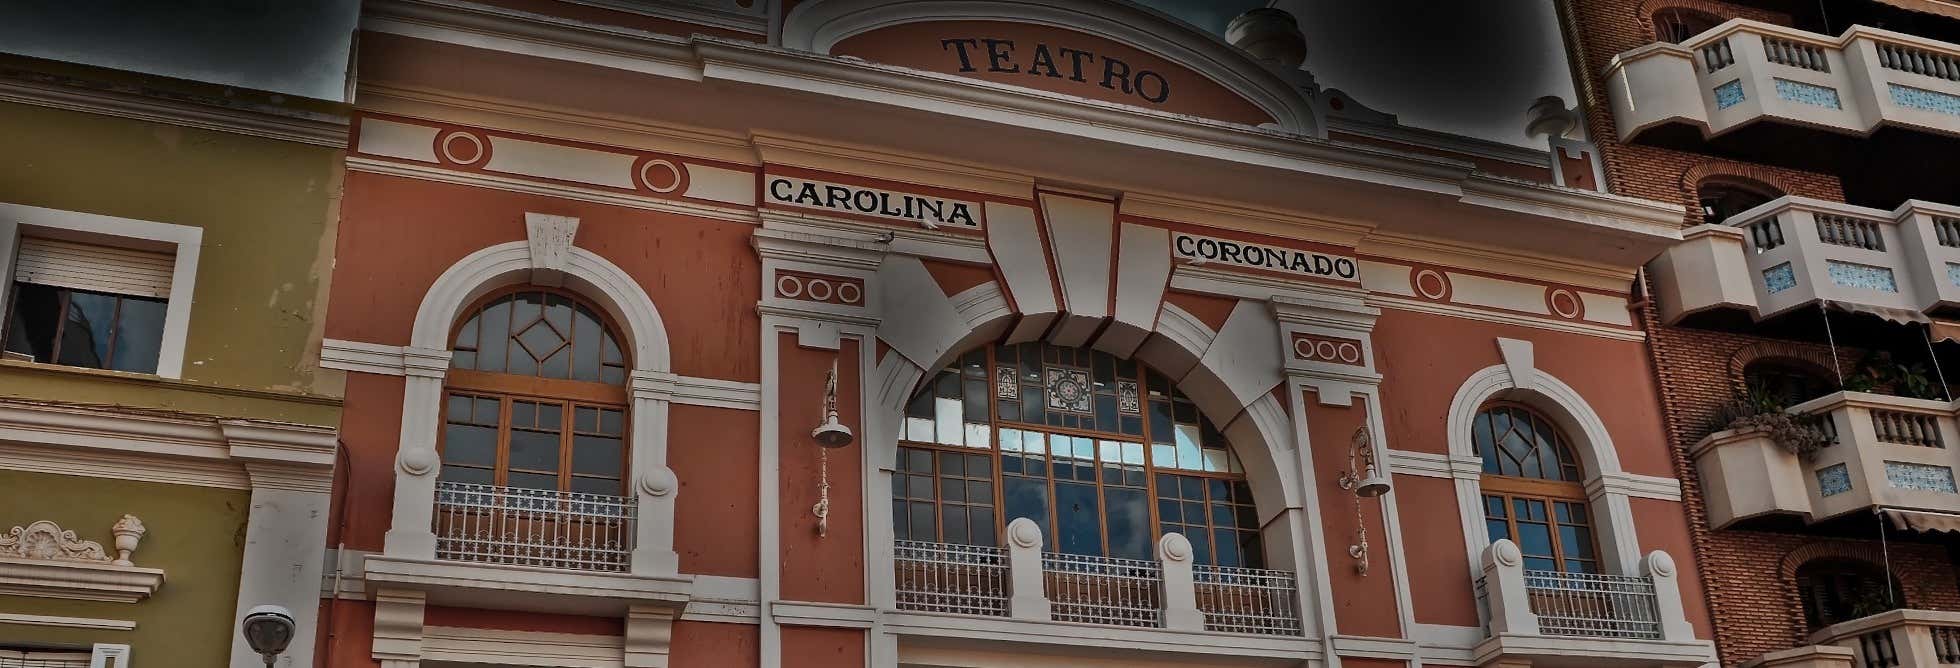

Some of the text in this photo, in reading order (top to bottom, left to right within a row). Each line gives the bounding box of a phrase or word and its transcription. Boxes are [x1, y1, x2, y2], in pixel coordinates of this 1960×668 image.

[942, 38, 1170, 103] TEATRO
[769, 178, 977, 226] CAROLINA
[1176, 235, 1356, 279] CORONADO
